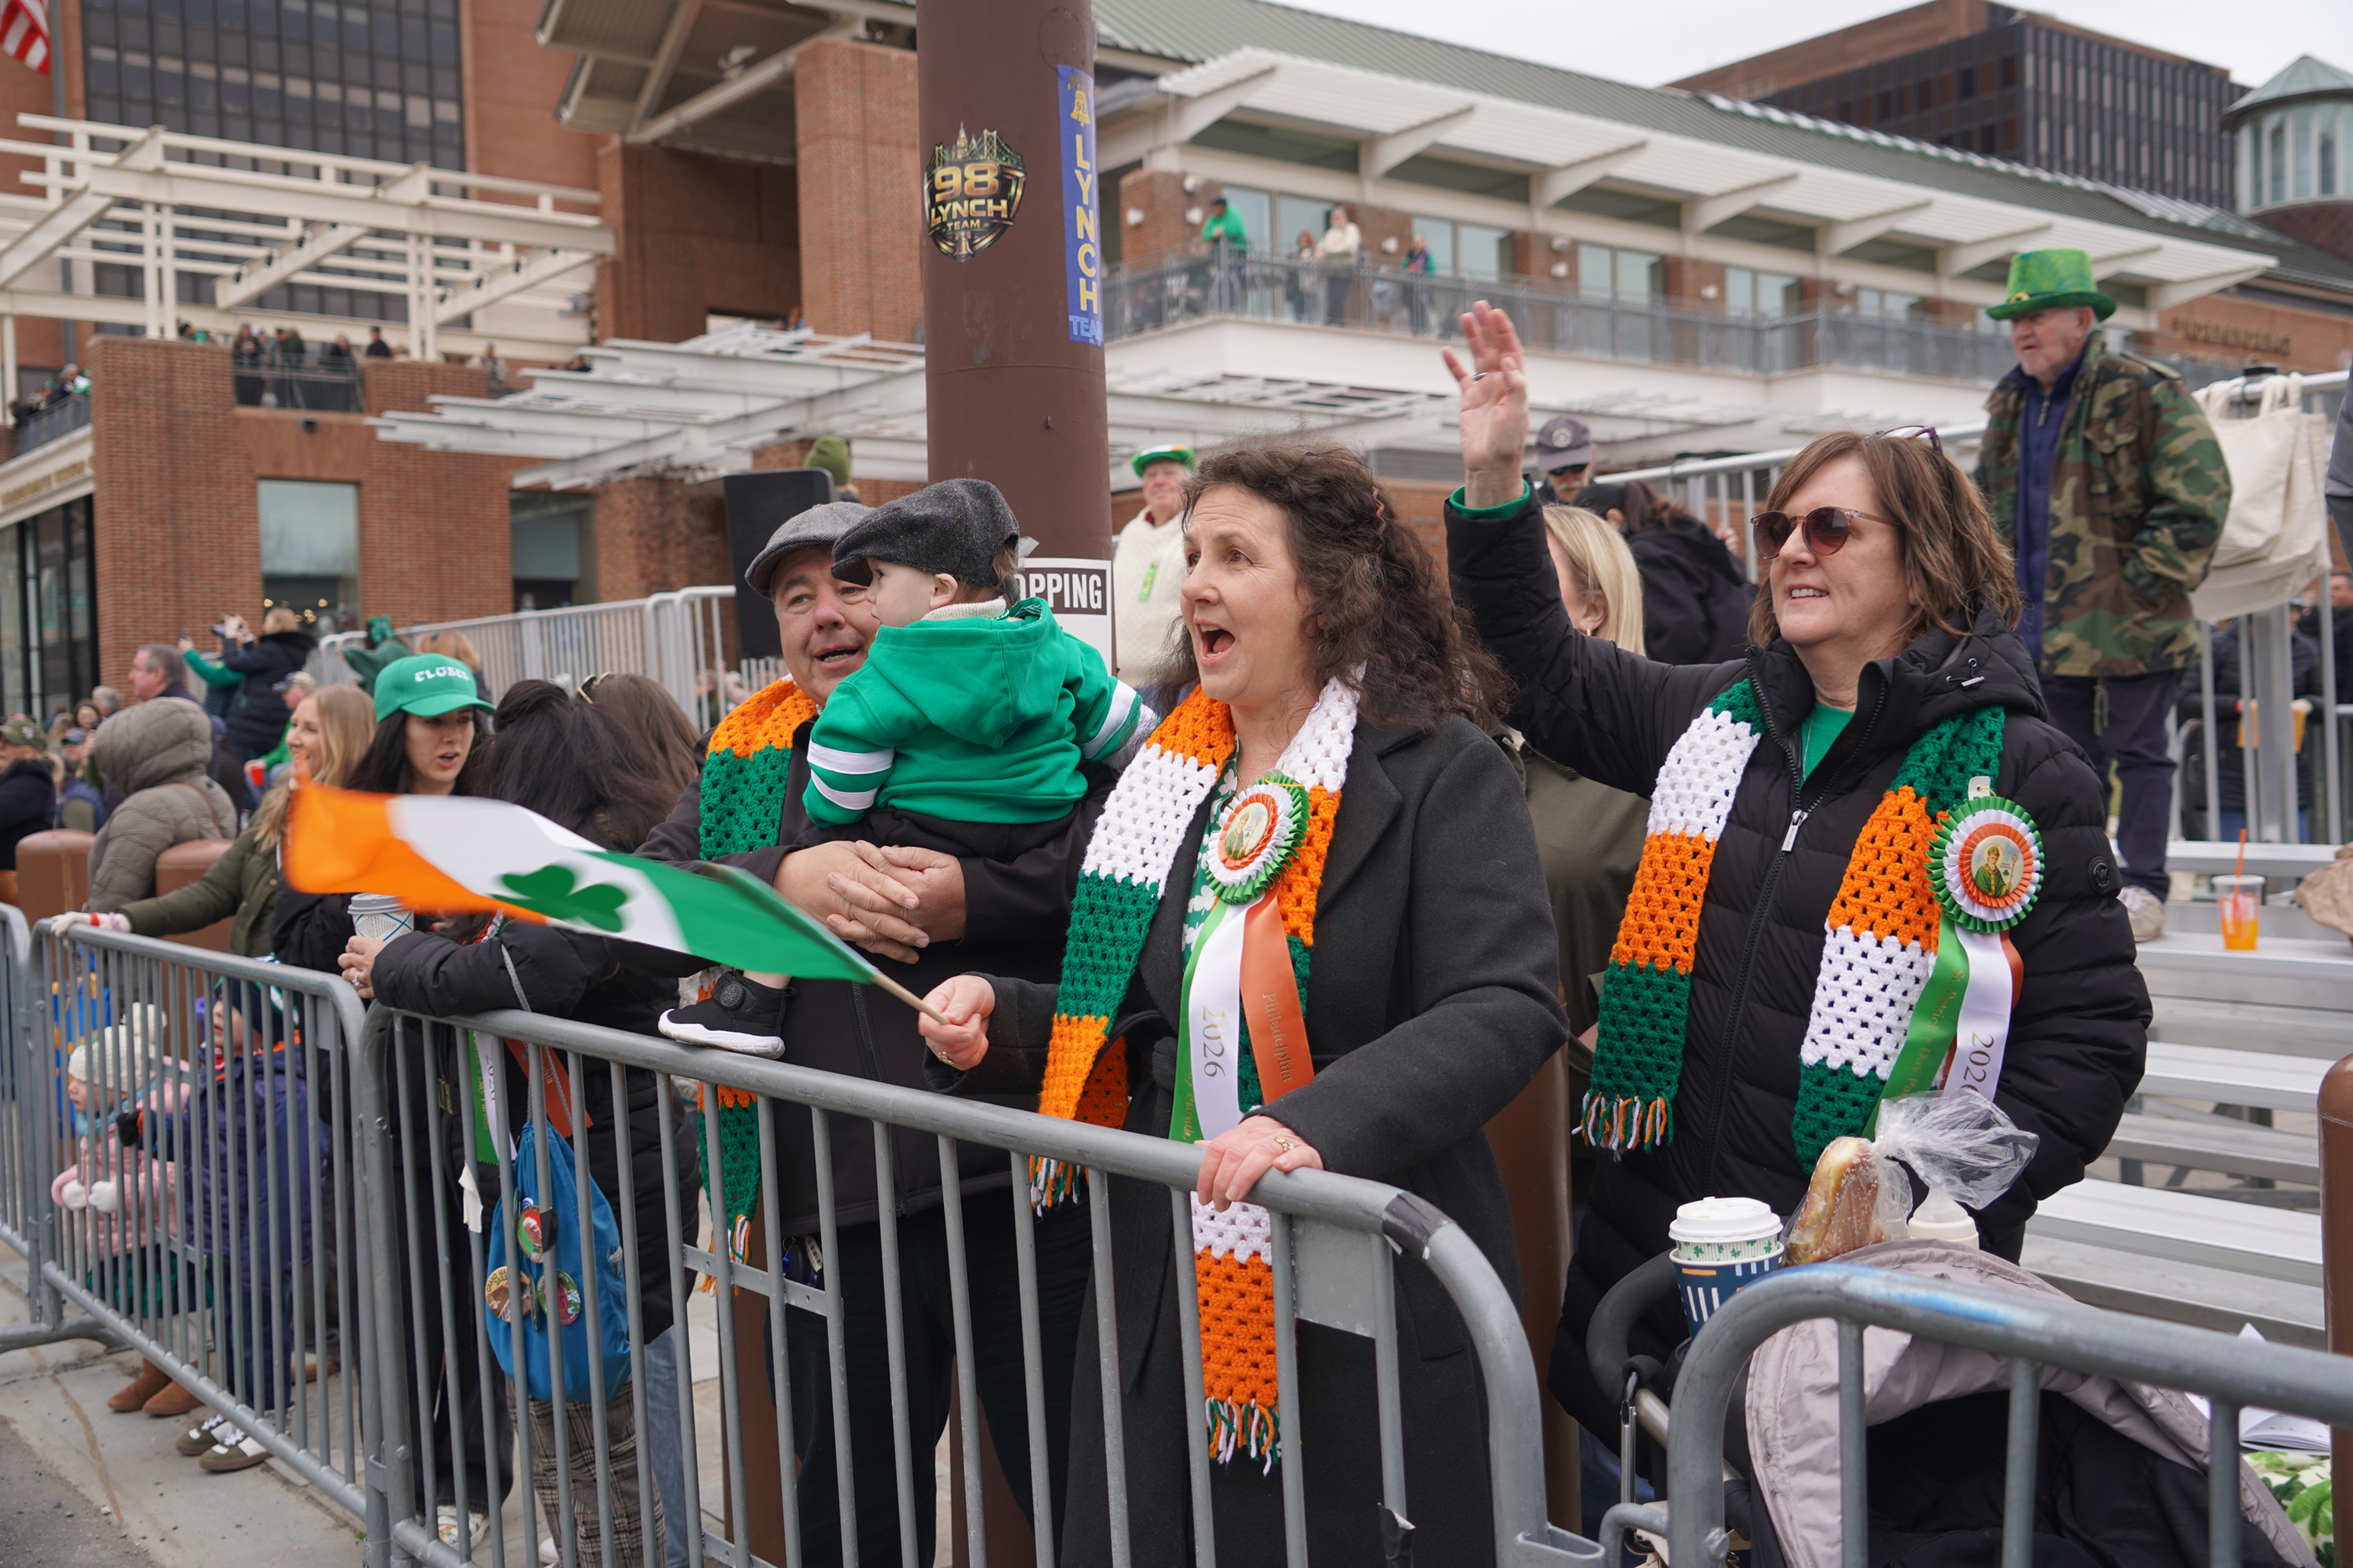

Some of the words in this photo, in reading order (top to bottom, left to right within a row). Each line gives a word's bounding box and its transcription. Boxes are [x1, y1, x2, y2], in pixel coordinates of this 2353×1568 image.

[1076, 101, 1087, 115] 98
[935, 162, 999, 203] 98
[931, 199, 1008, 227] LYNCH
[947, 219, 981, 231] TEAM
[1075, 134, 1098, 314] LYNCH
[1949, 967, 1965, 984] St.
[1924, 989, 1957, 1044] Patrick's
[1202, 1004, 1225, 1077] 2026
[1262, 991, 1294, 1082] Philadelphia
[1910, 1047, 1931, 1074] Day
[486, 1273, 498, 1292] GRAND
